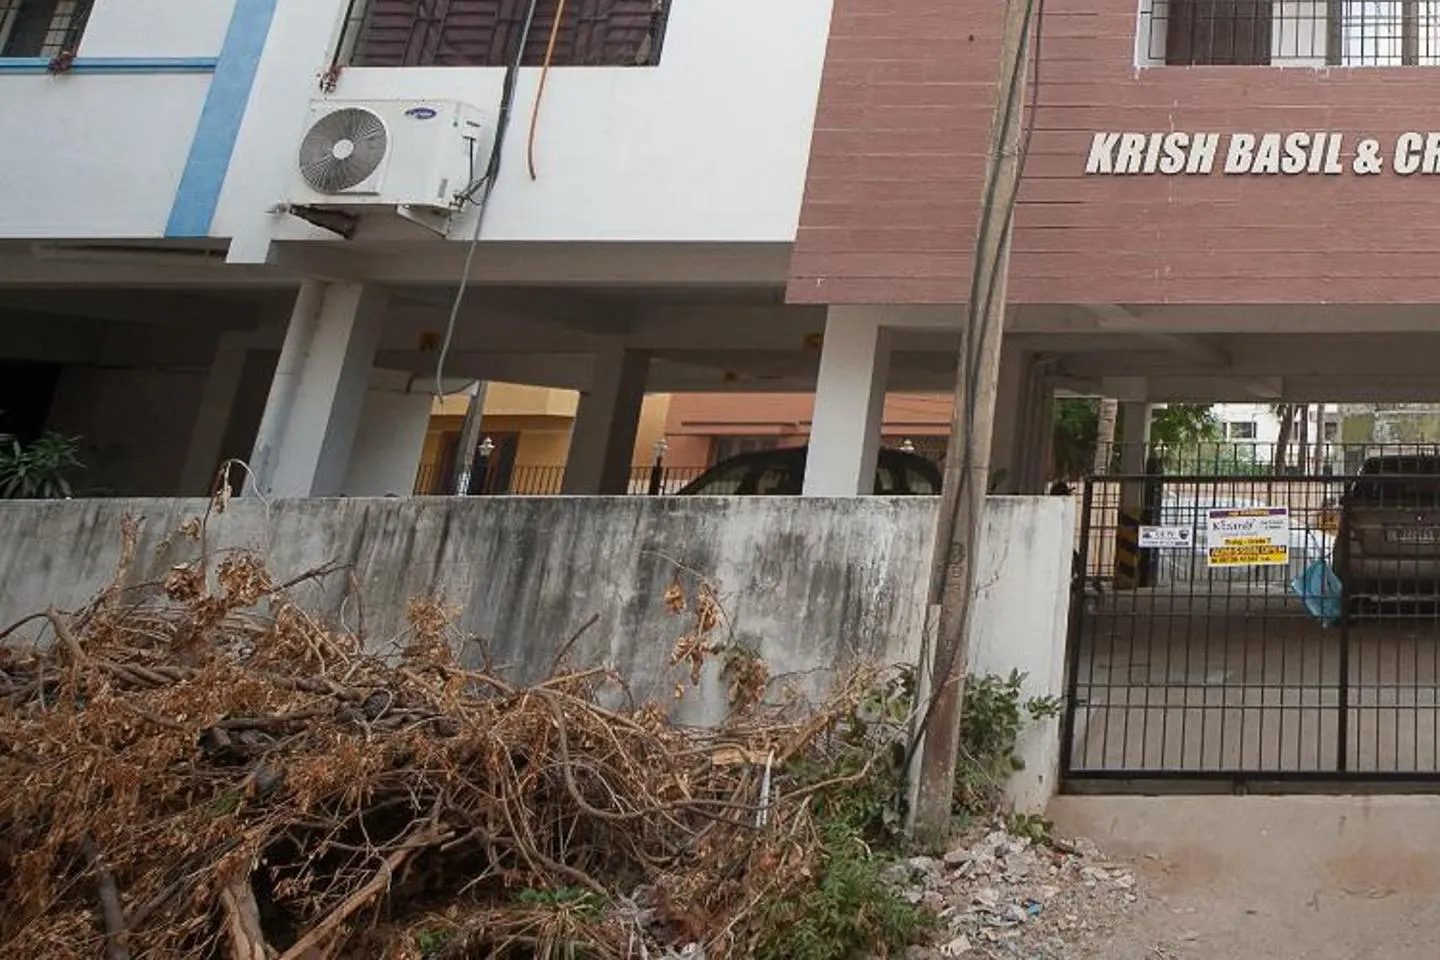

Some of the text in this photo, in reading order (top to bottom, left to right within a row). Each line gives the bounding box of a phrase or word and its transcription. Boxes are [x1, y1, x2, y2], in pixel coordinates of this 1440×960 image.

[1085, 131, 1220, 175] KRISH
[1224, 131, 1344, 175] BASIL
[1352, 138, 1385, 175] &
